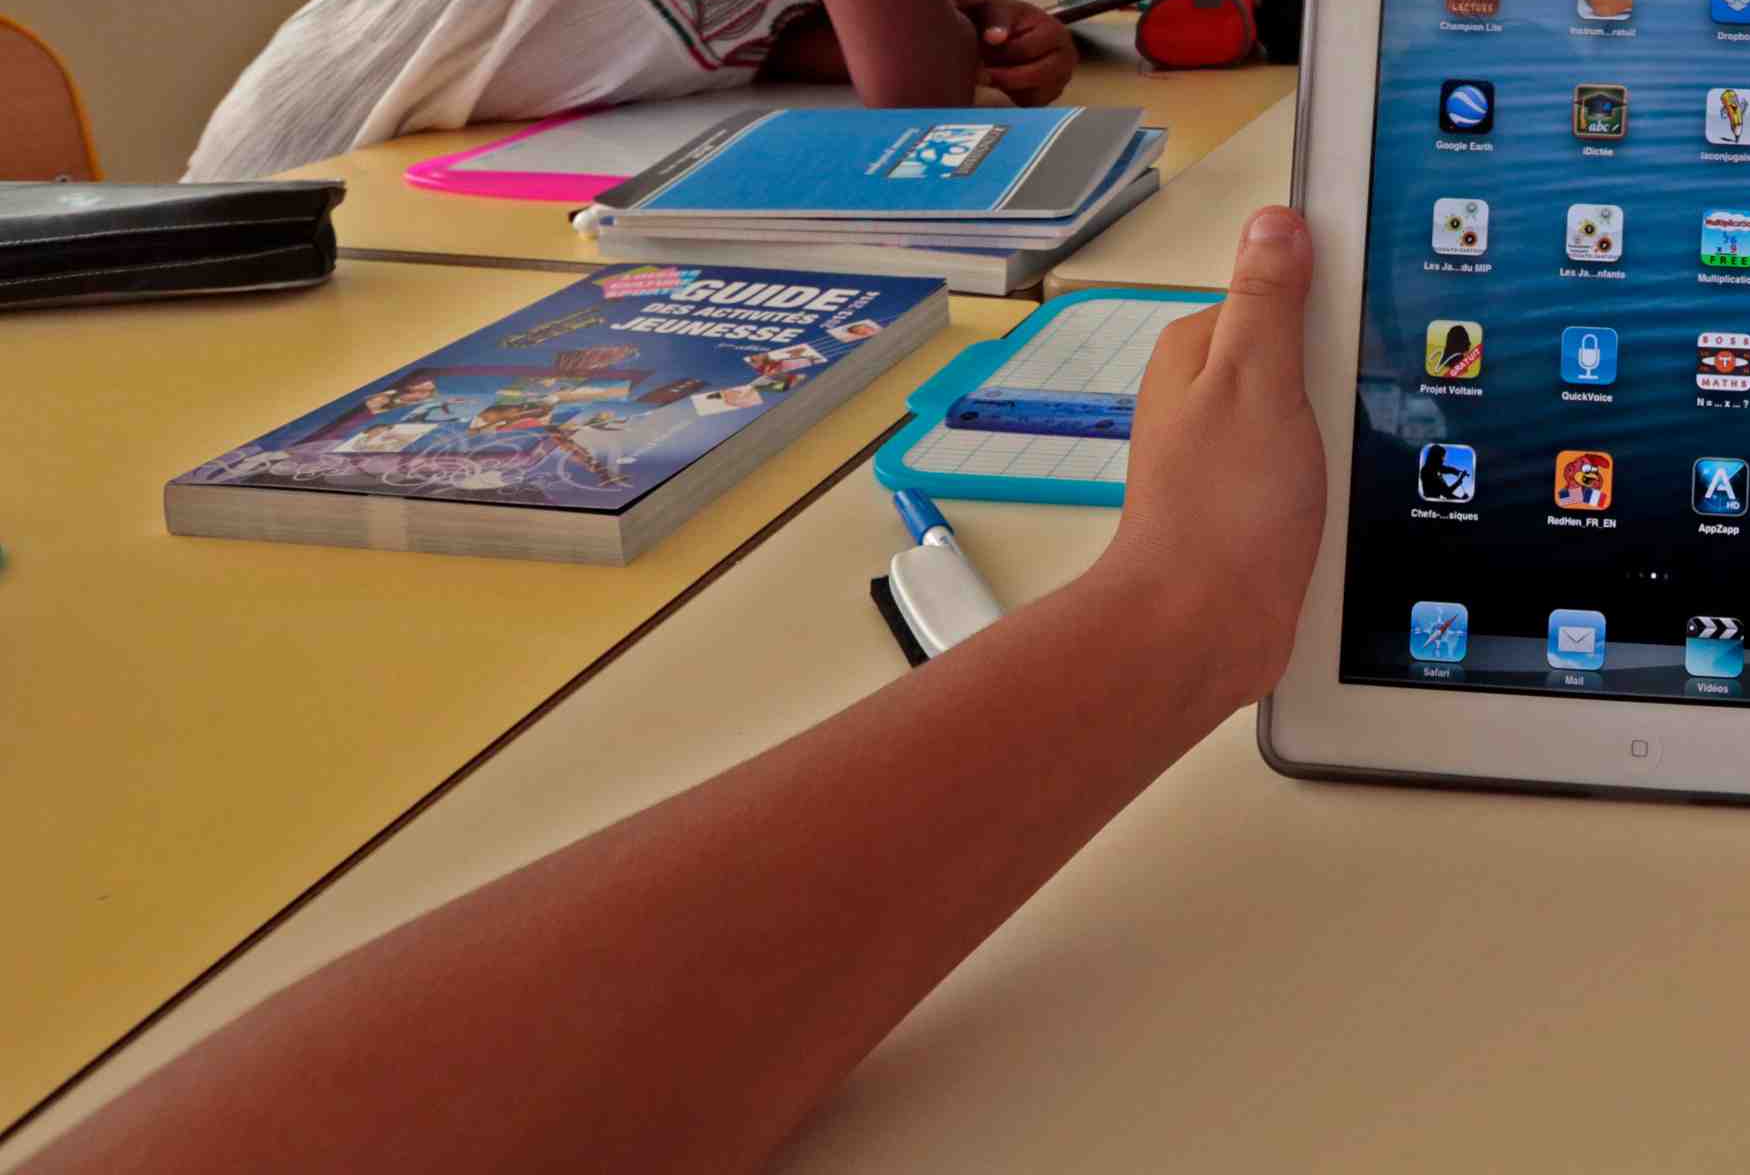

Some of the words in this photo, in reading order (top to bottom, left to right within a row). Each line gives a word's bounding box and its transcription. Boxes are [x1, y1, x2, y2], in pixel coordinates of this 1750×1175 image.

[1440, 21, 1485, 34] Champion
[1435, 139, 1468, 152] Google
[1469, 140, 1494, 152] Earth
[1423, 260, 1439, 272] Les
[1474, 262, 1493, 273] MIP
[1709, 254, 1749, 266] FREE
[1559, 267, 1576, 278] Les
[670, 279, 860, 312] GUIDE
[640, 302, 695, 316] DES
[693, 302, 822, 325] ACTIVITÉS
[610, 316, 804, 343] JEUNESSE
[1450, 346, 1482, 378] GRATUIT
[1419, 383, 1448, 395] Projet
[1449, 384, 1483, 396] Voltaire
[1700, 377, 1749, 389] MATHS
[1561, 391, 1614, 403] QuickVoice
[1704, 468, 1737, 501] A
[1726, 501, 1741, 511] HD
[1547, 515, 1617, 529] RedHen_FR_EN
[1698, 523, 1740, 536] AppZapp
[1423, 667, 1450, 679] Safari
[1565, 675, 1585, 687] Mail
